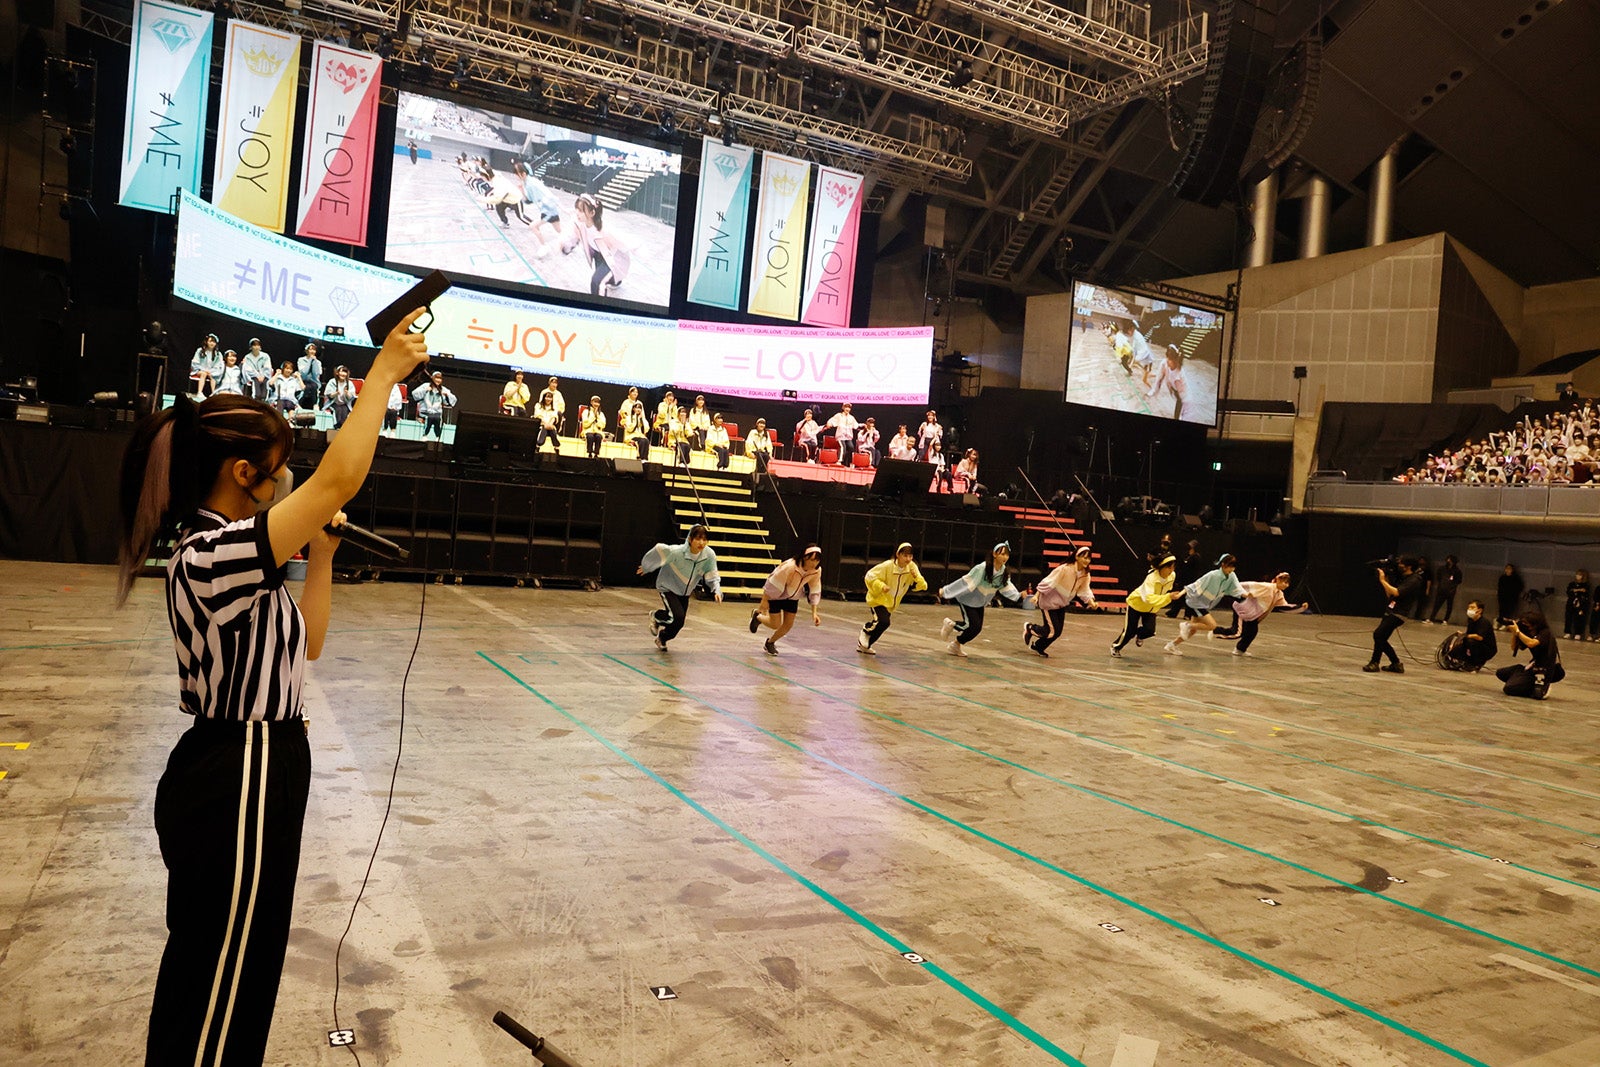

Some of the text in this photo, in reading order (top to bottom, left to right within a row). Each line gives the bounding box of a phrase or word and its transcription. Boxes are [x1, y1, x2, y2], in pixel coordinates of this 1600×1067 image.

[145, 92, 183, 170] ≠ME
[236, 105, 272, 193] ≒JOY
[319, 114, 355, 216] =LOVE
[705, 210, 730, 272] ≠ME
[817, 225, 844, 306] =LOVE
[232, 258, 312, 312] ≠ME
[339, 260, 354, 269] EQUAL
[380, 271, 396, 281] EQUAL
[467, 293, 486, 302] NEARLY
[521, 303, 540, 311] NEARLY
[595, 314, 611, 322] EQUAL
[467, 318, 577, 362] ≒JOY
[723, 349, 855, 383] =LOVE
[657, 987, 676, 999] 7
[329, 1030, 353, 1045] 8
